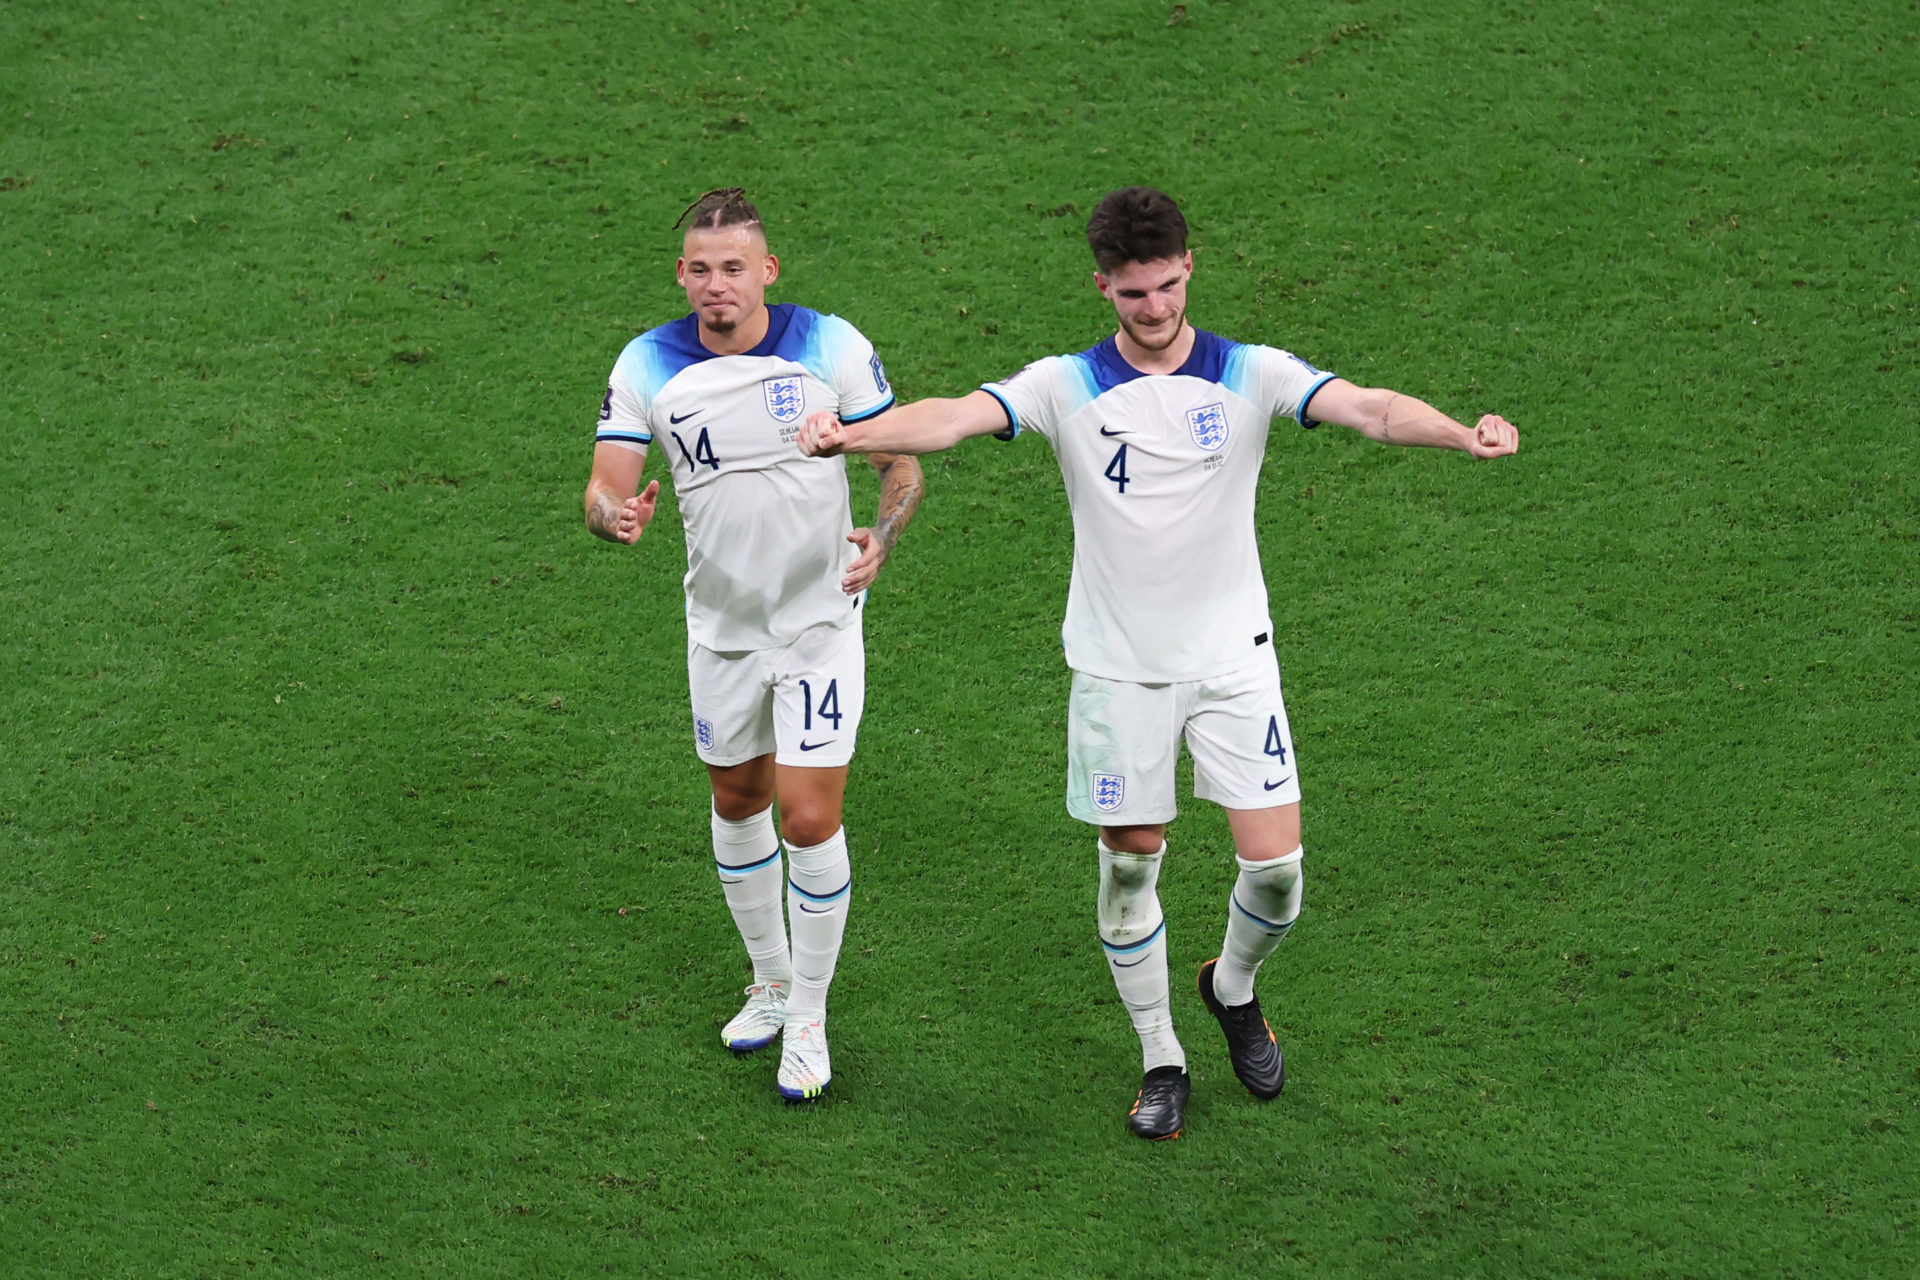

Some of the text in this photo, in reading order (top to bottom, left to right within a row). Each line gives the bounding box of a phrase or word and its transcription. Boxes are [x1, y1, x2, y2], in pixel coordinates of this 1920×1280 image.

[671, 426, 720, 473] 14
[1104, 443, 1130, 493] 4
[799, 678, 842, 730] 14
[1264, 714, 1286, 765] 4
